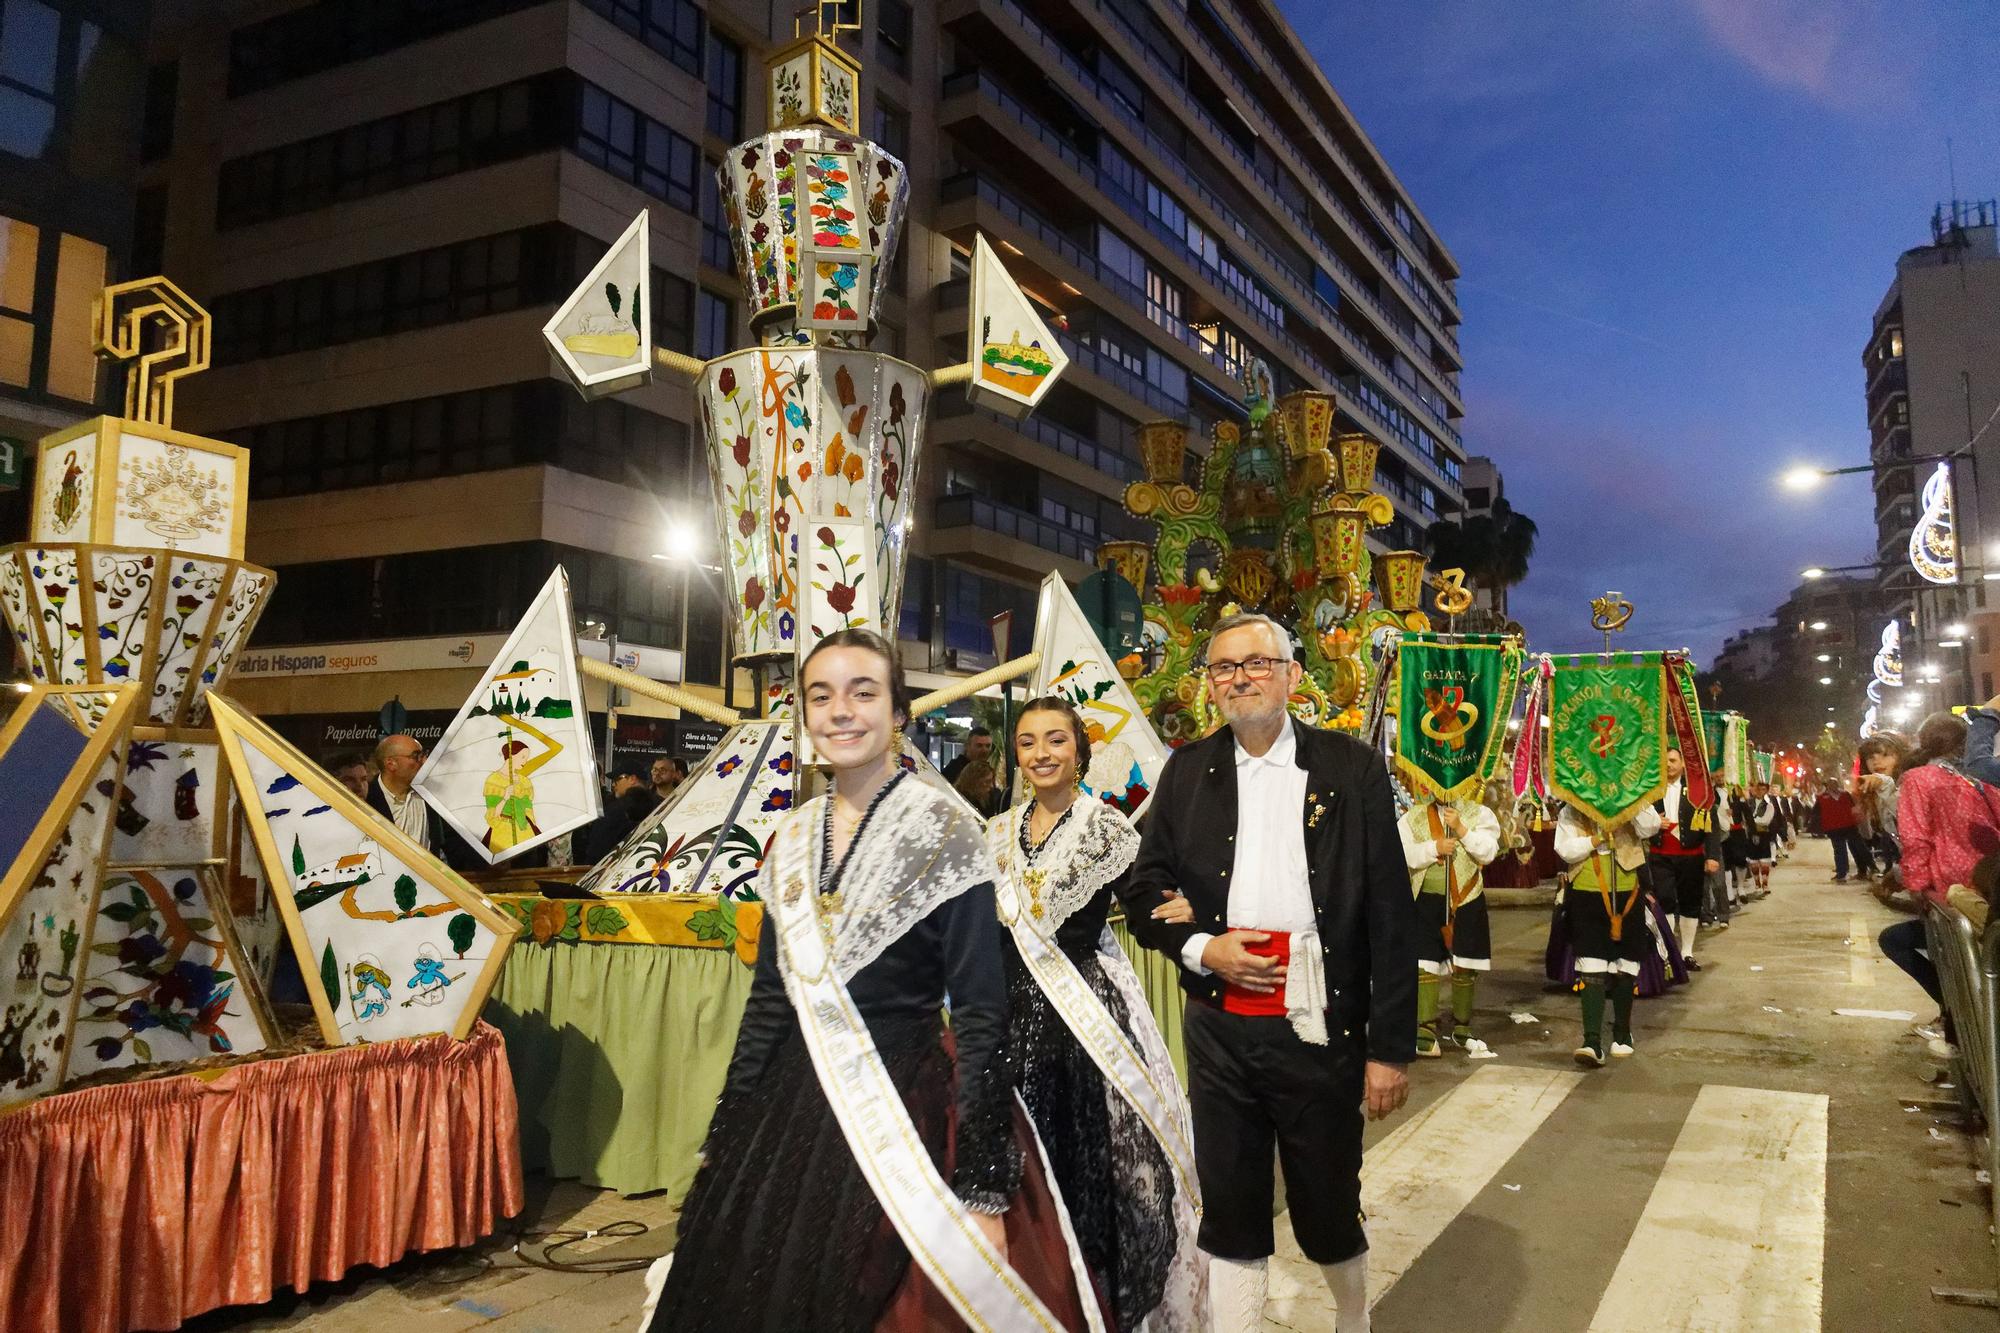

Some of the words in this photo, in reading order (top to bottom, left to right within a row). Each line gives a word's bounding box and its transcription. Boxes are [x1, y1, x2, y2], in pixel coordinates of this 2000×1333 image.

[235, 656, 268, 673] atria
[272, 654, 326, 673] Hispana
[329, 654, 377, 671] seguros
[1423, 670, 1467, 681] GAIATA
